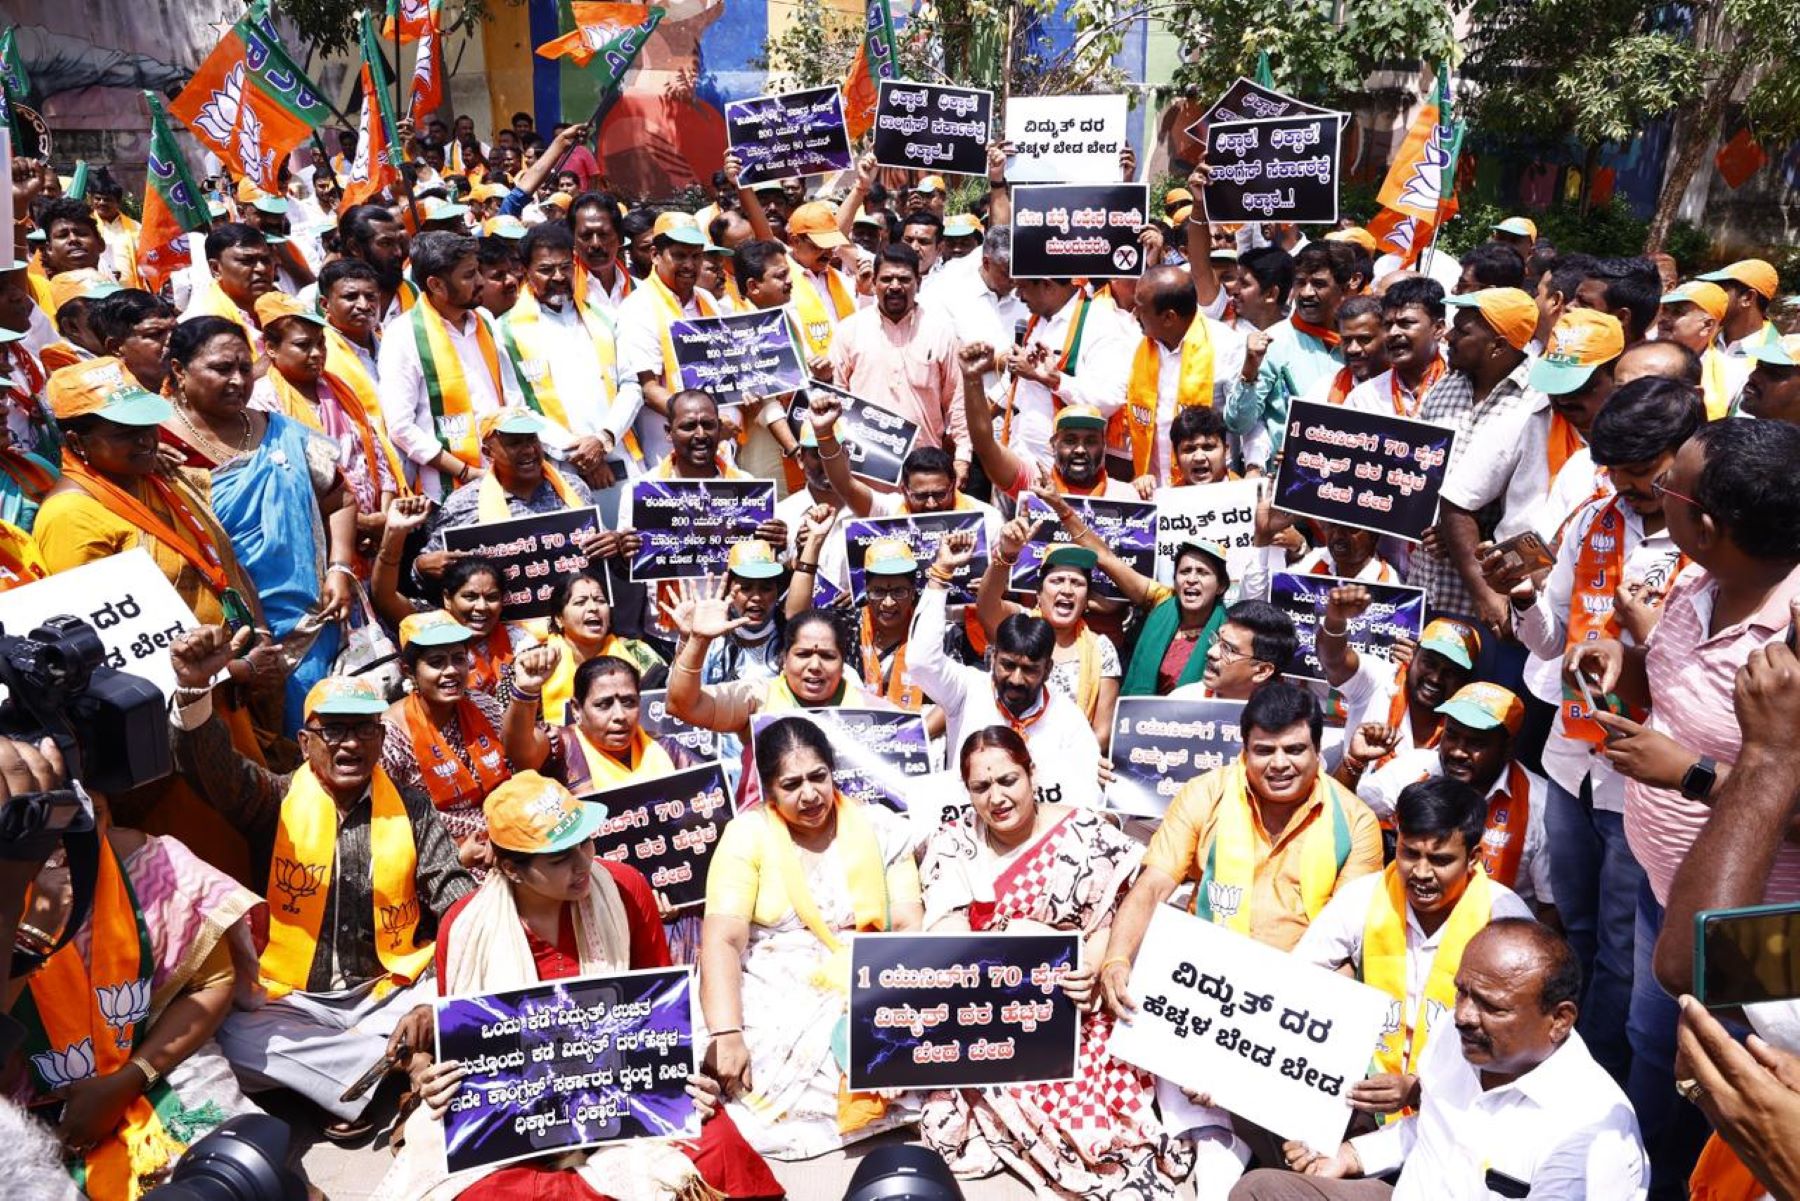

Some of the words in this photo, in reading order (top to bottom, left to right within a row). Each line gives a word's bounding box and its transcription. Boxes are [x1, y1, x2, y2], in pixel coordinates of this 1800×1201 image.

[758, 129, 773, 140] 200
[1024, 118, 1075, 139] ವಿದ್ಯುತ್
[1080, 118, 1105, 133] ದರ
[1053, 140, 1083, 154] ಬೇಡ
[1087, 140, 1117, 154] ಬೇಡ
[1290, 420, 1301, 438] 1
[1384, 438, 1410, 459] 70
[1355, 461, 1383, 481] ದರ
[671, 516, 689, 527] 200
[1159, 509, 1216, 536] ವಿದ್ಯುತ್
[1222, 505, 1252, 525] ದರ
[541, 532, 566, 550] 70
[1592, 570, 1605, 589] J
[90, 593, 142, 632] ದರ
[1118, 717, 1130, 735] 1
[654, 799, 685, 823] 70
[634, 834, 667, 859] ದರ
[672, 821, 718, 855] ಹೆಚ್ಚಳ
[651, 859, 693, 888] ಬೇಡ
[857, 965, 870, 989] 1
[988, 965, 1022, 988] 70
[1171, 960, 1275, 1017] ವಿದ್ಯುತ್
[1279, 1007, 1334, 1045] ದರ
[481, 1014, 521, 1040] ಒಂದು
[557, 1001, 606, 1030] ವಿದ್ಯುತ್
[613, 997, 653, 1020] ಉಚಿತ
[874, 1001, 950, 1037] ವಿದ್ಯುತ್
[956, 1001, 993, 1026] ದರ
[1001, 998, 1054, 1033] ಹೆಚ್ಚಳ
[561, 1033, 610, 1065] ವಿದ್ಯುತ್
[616, 1031, 641, 1052] ದರ
[645, 1028, 681, 1057] ಹೆಚ್ಚಳ
[912, 1039, 960, 1064] ಬೇಡ
[968, 1036, 1016, 1061] ಬೇಡ
[1142, 994, 1213, 1038] ಹೆಚ್ಚಳ
[1215, 1026, 1276, 1069] ಬೇಡ
[1279, 1055, 1346, 1098] ಬೇಡ
[487, 1076, 548, 1108] ಕಾಂಗ್ರೆಸ್
[552, 1069, 614, 1093] ಸರ್ಕಾರದ
